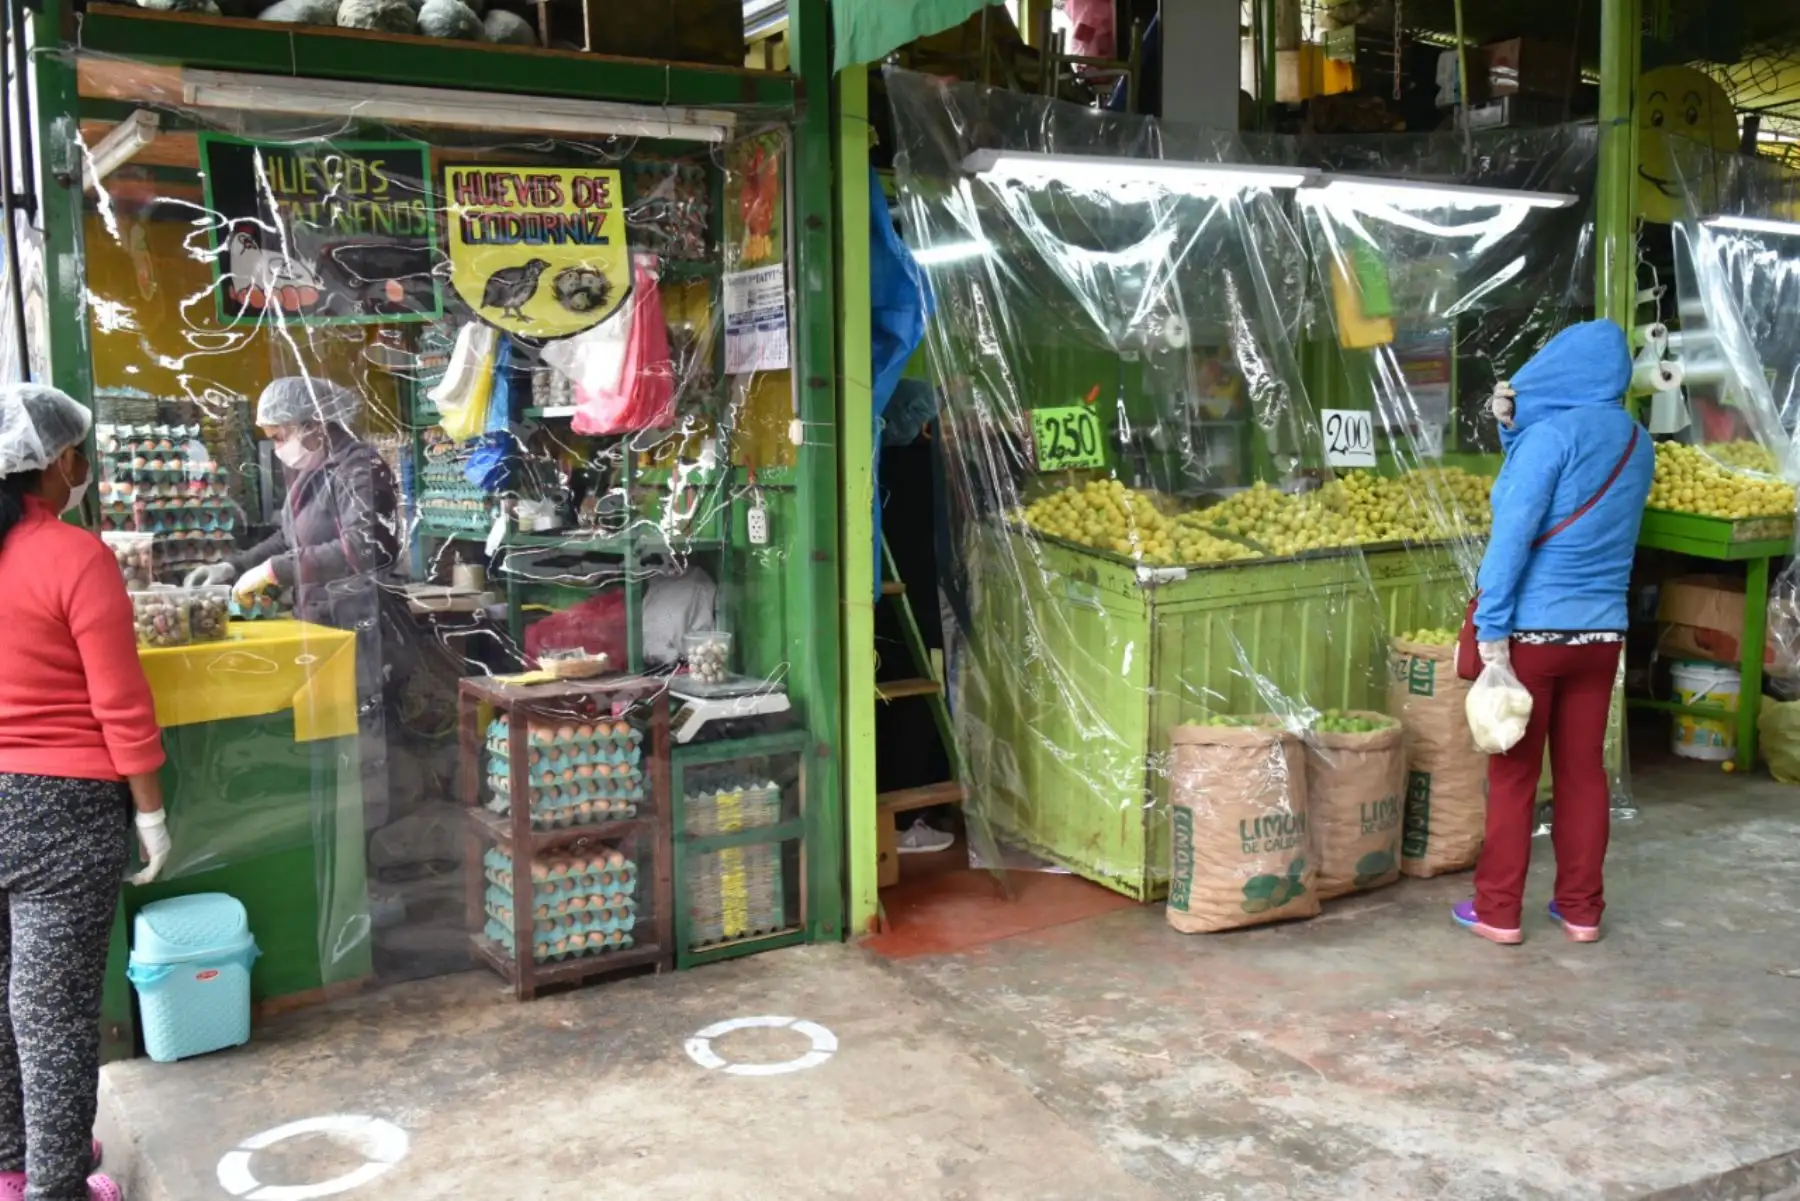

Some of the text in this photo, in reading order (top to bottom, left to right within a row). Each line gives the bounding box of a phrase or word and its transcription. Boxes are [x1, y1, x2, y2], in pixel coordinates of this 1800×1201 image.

[255, 155, 390, 197] HUEVOS
[452, 171, 612, 209] HUEVOS DE
[1171, 809, 1190, 906] LIMONES
[1242, 841, 1259, 854] DE
